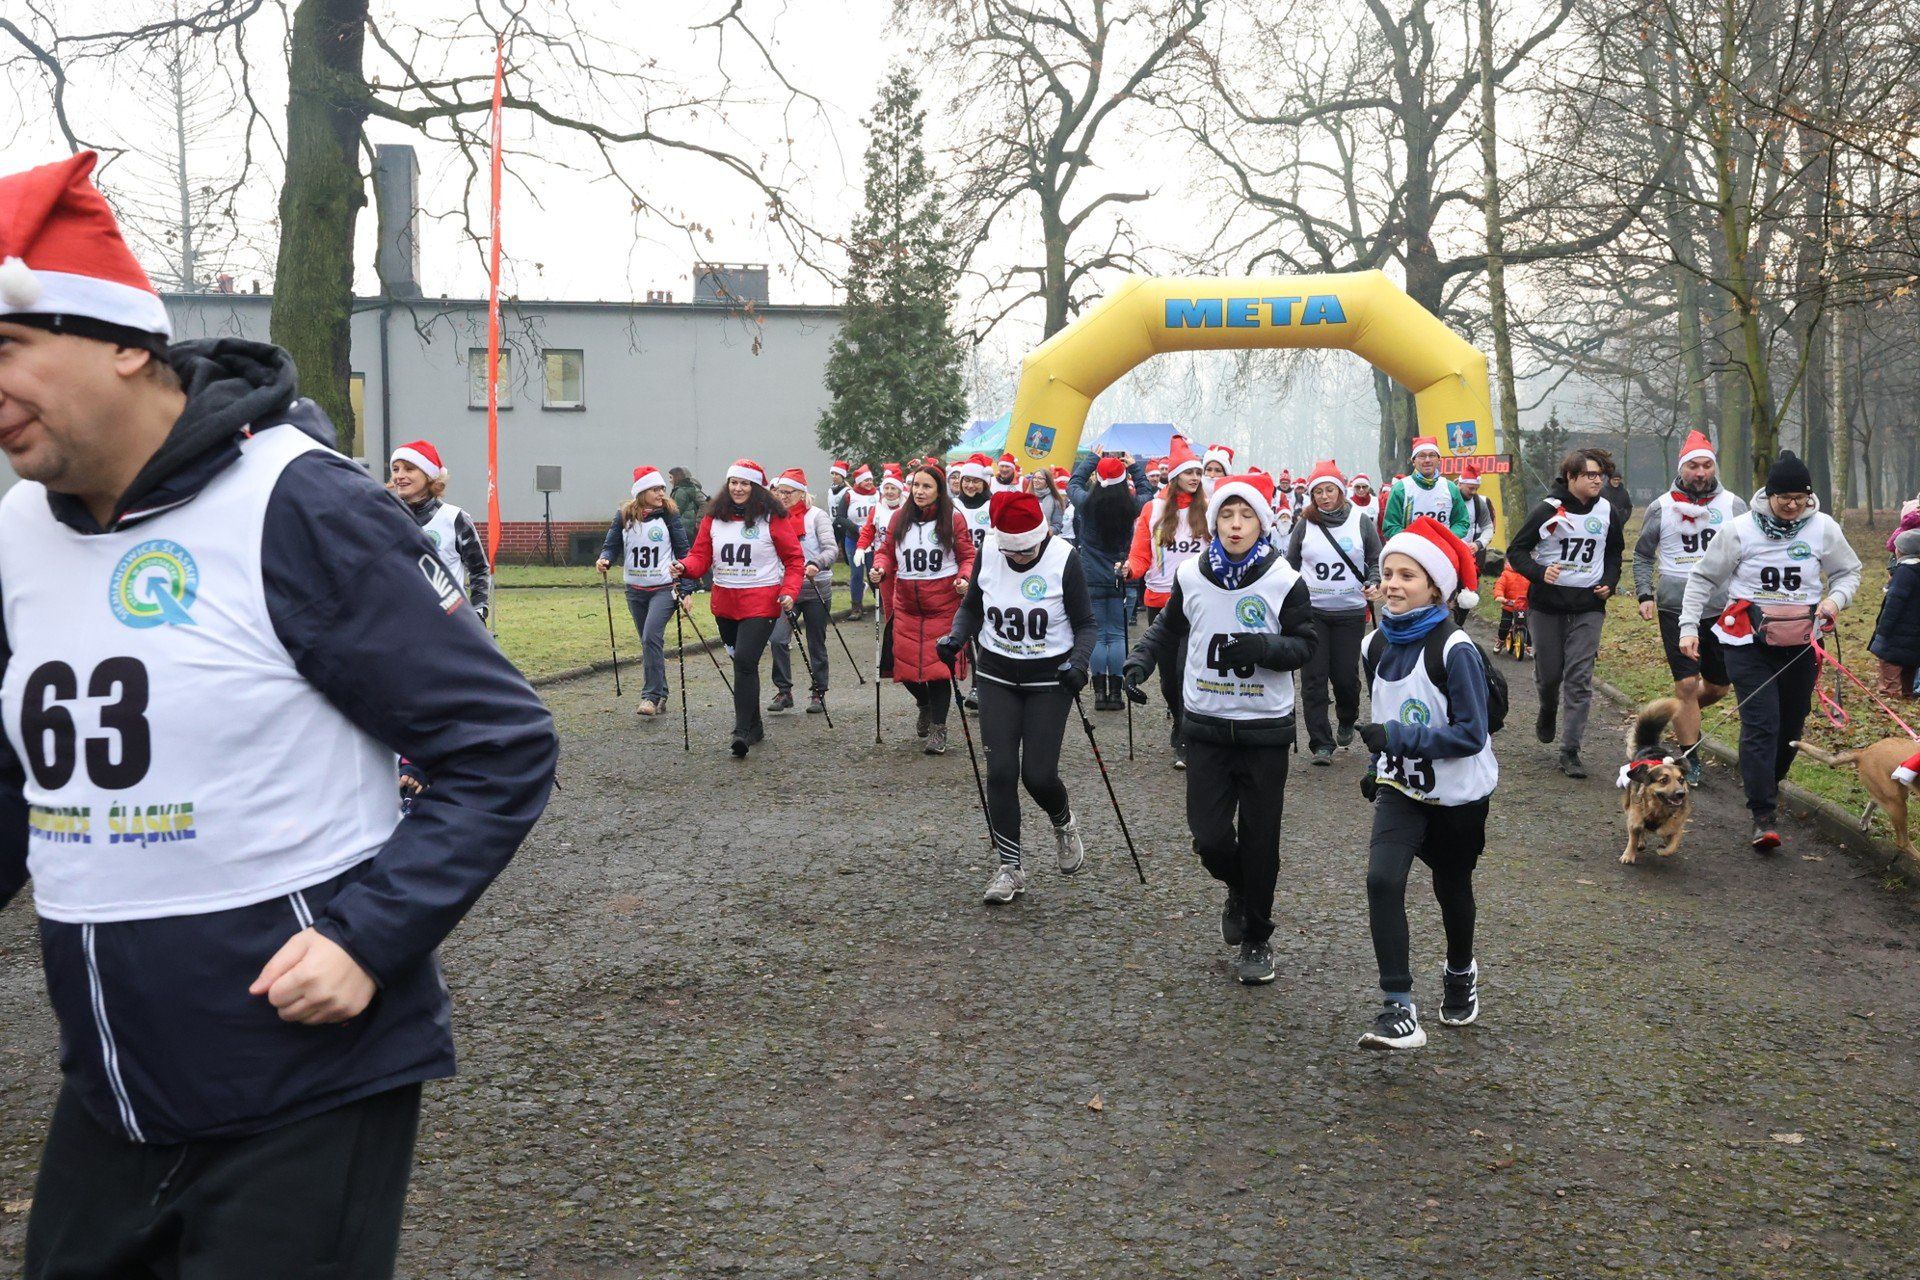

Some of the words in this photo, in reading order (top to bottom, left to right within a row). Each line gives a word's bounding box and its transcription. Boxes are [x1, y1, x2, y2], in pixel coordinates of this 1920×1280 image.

[1165, 295, 1347, 328] META
[632, 546, 659, 568] 131
[720, 543, 752, 567] 44
[1167, 540, 1201, 553] 492
[1559, 537, 1597, 563] 173
[902, 548, 943, 573] 189
[1315, 562, 1346, 581] 92
[1760, 566, 1801, 592] 95
[987, 606, 1049, 642] 230
[21, 656, 152, 790] 63
